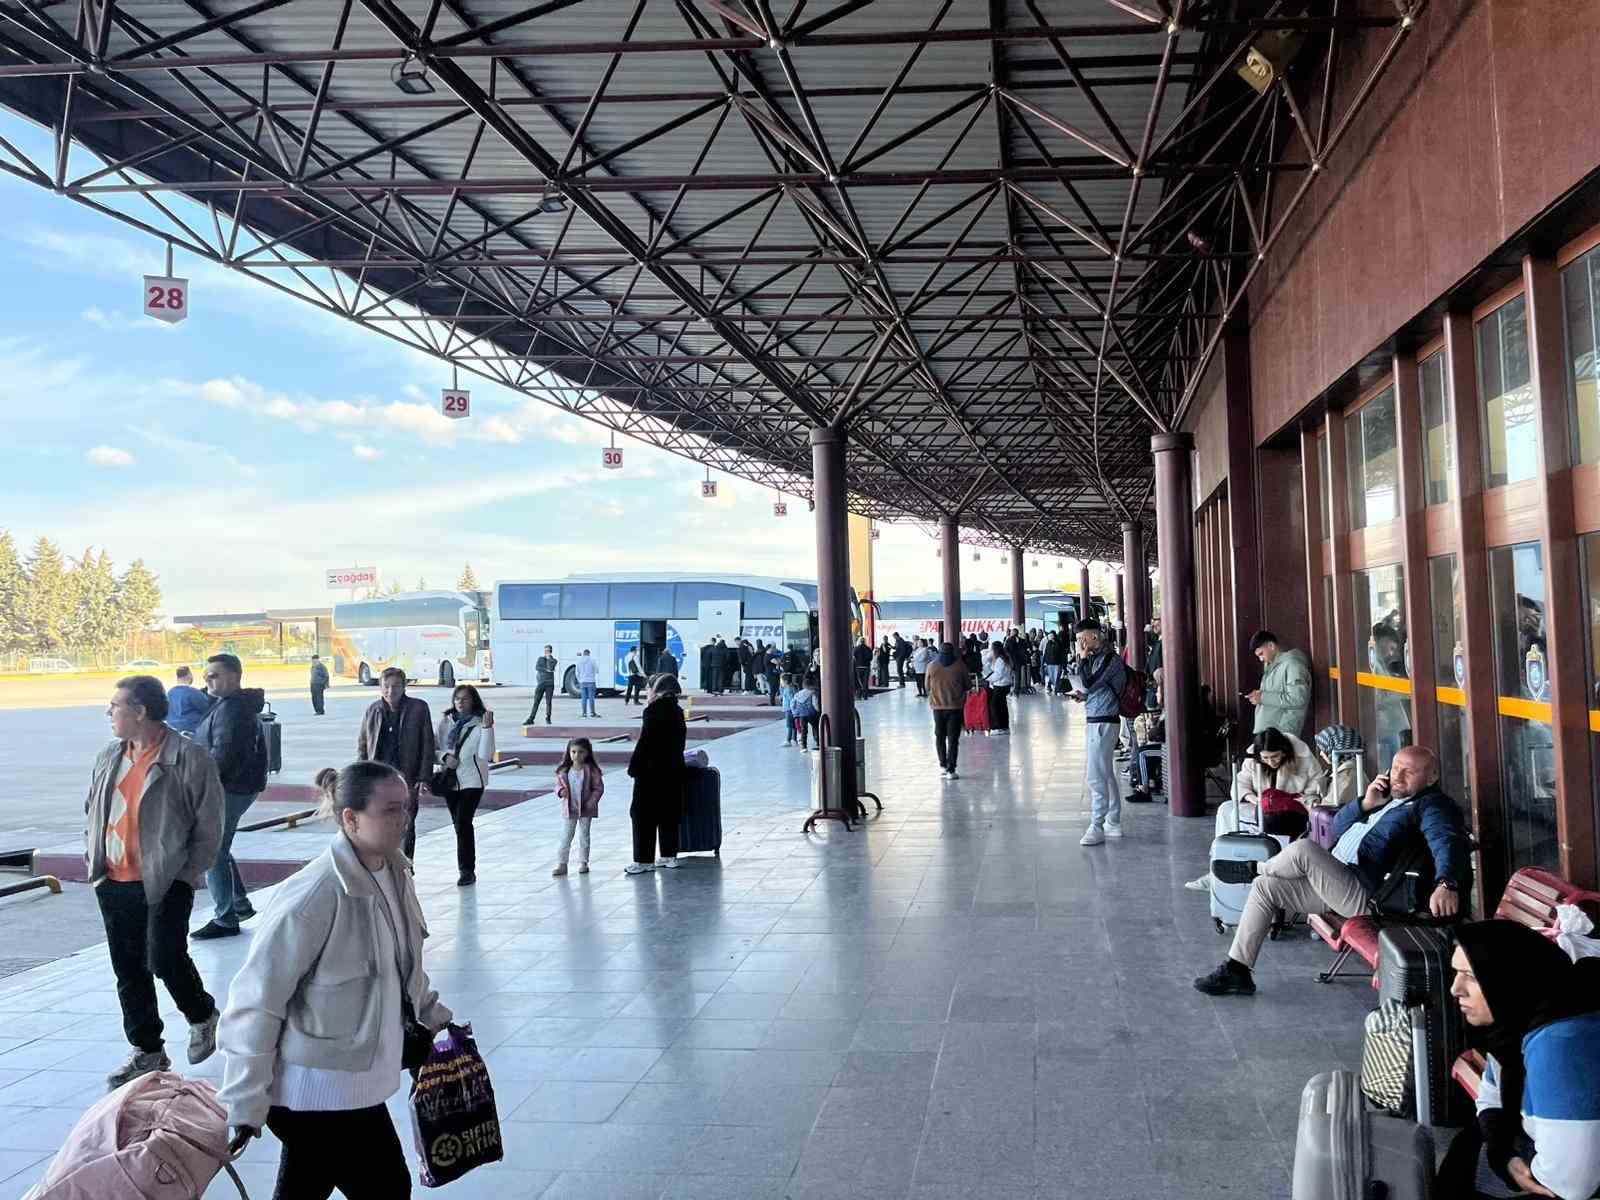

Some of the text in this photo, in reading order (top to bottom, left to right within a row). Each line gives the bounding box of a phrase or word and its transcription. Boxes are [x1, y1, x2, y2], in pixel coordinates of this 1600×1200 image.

[149, 286, 183, 309] 28
[445, 396, 467, 411] 29
[604, 452, 621, 464] 30
[703, 485, 715, 495] 31
[741, 625, 783, 637] ETRO
